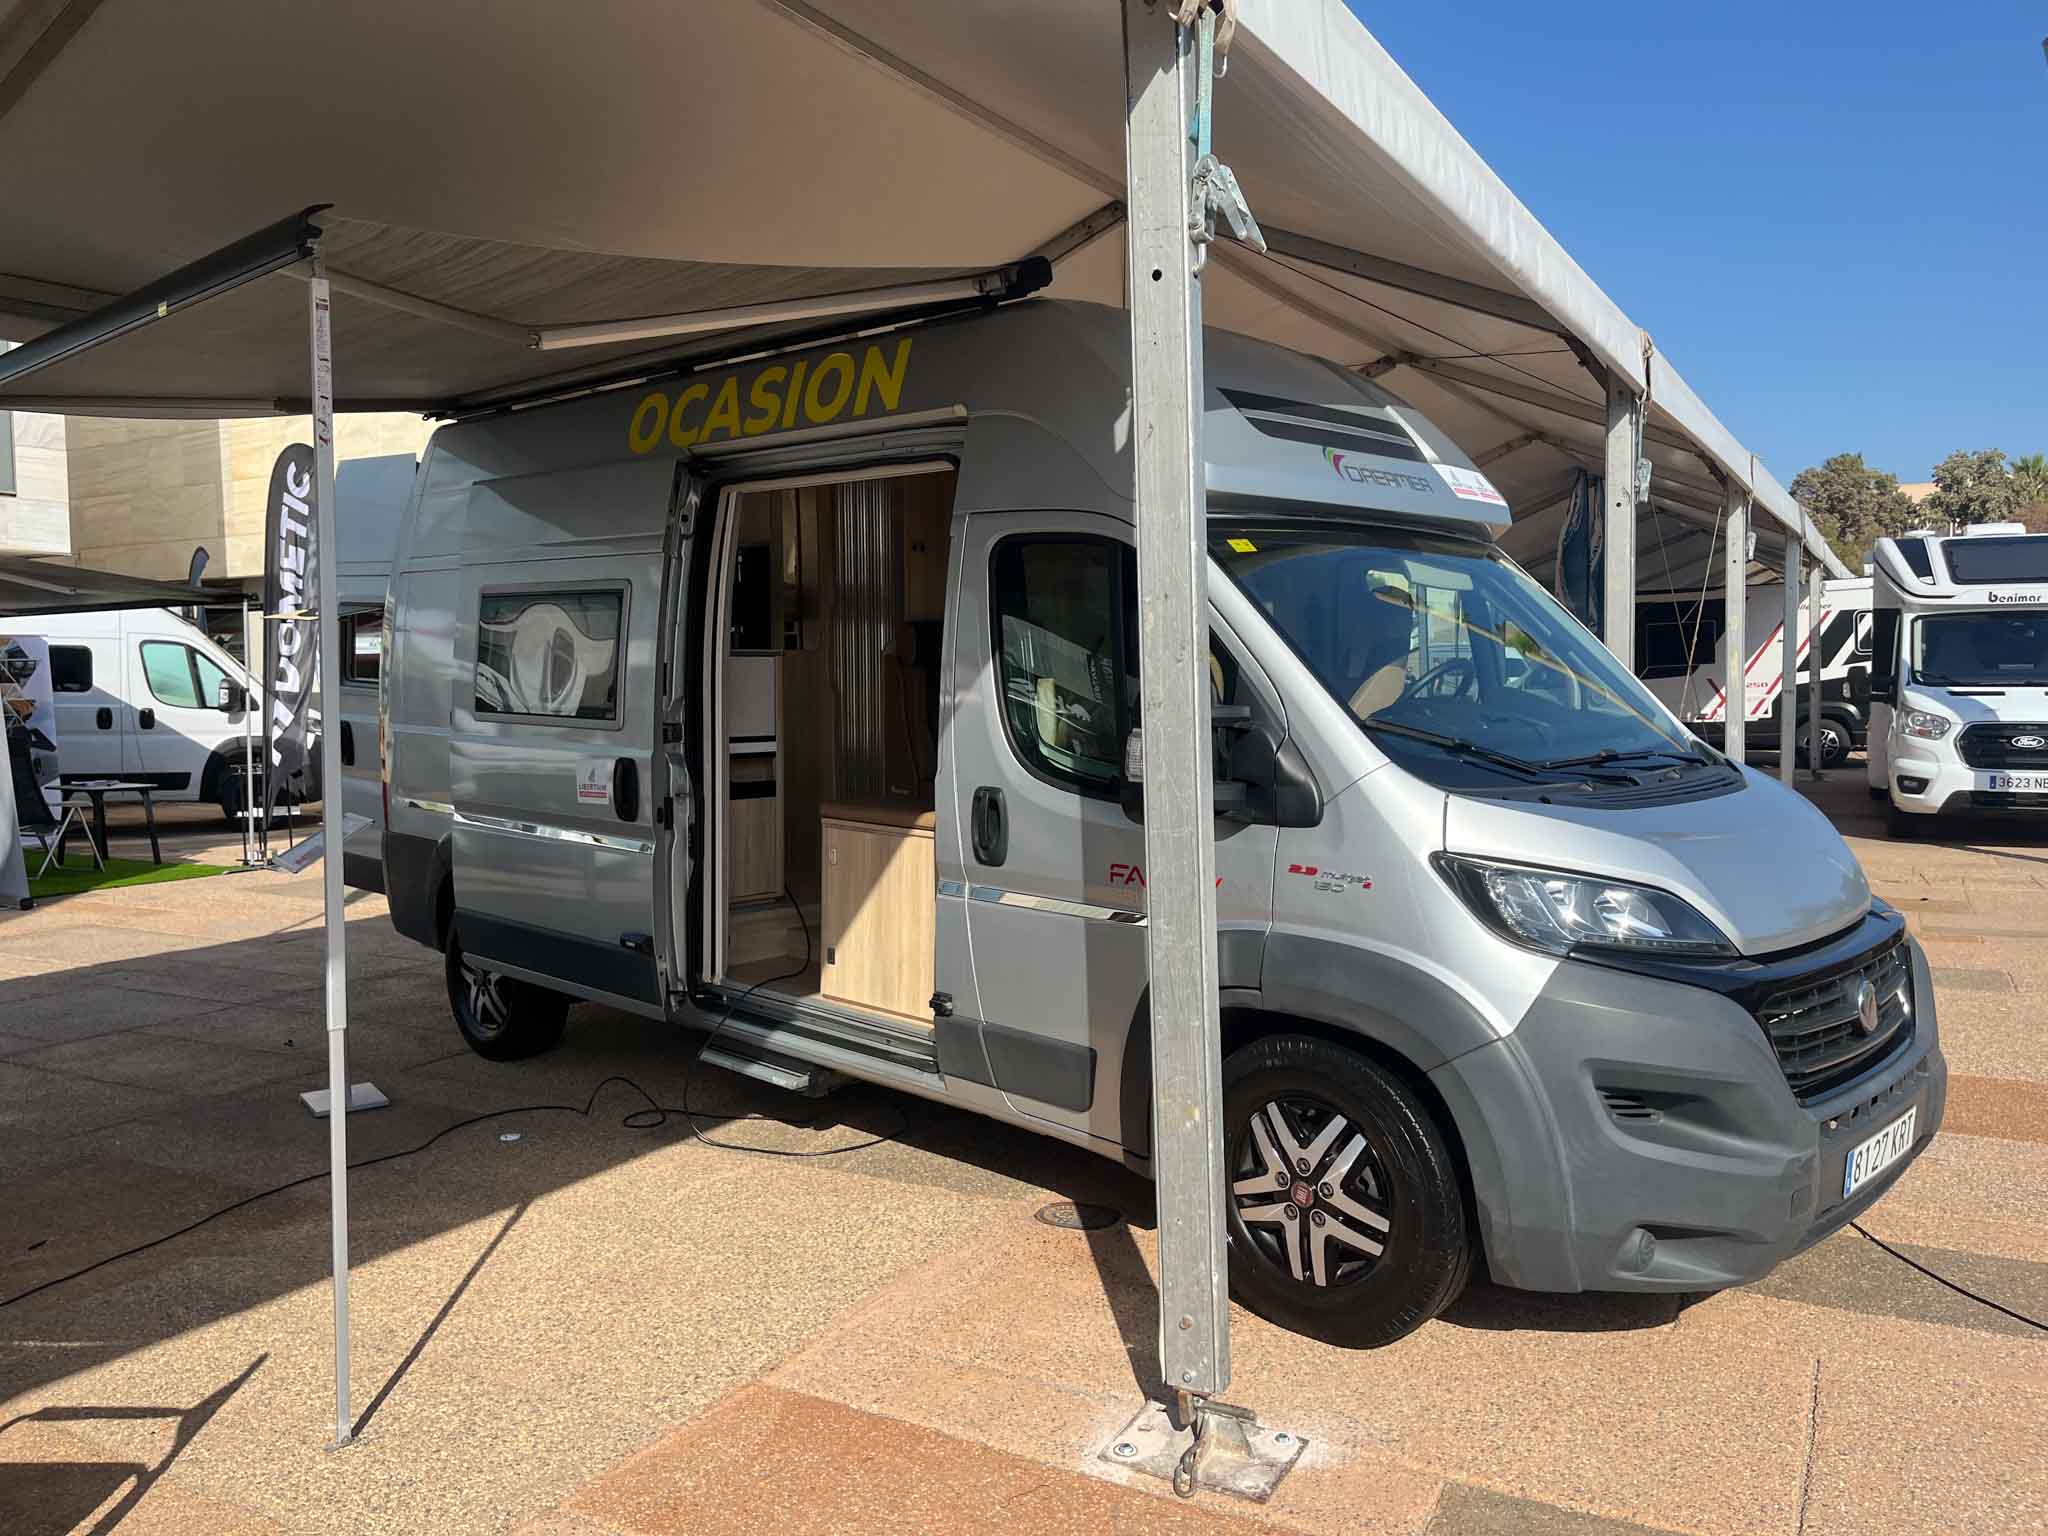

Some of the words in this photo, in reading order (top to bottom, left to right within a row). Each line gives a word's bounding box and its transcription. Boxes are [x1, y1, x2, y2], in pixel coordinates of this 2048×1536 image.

[628, 337, 913, 455] OCASION
[1988, 591, 2042, 603] benimar
[1999, 776, 2031, 788] 3623
[1854, 1132, 1888, 1183] 8127
[1891, 1114, 1913, 1157] KRT
